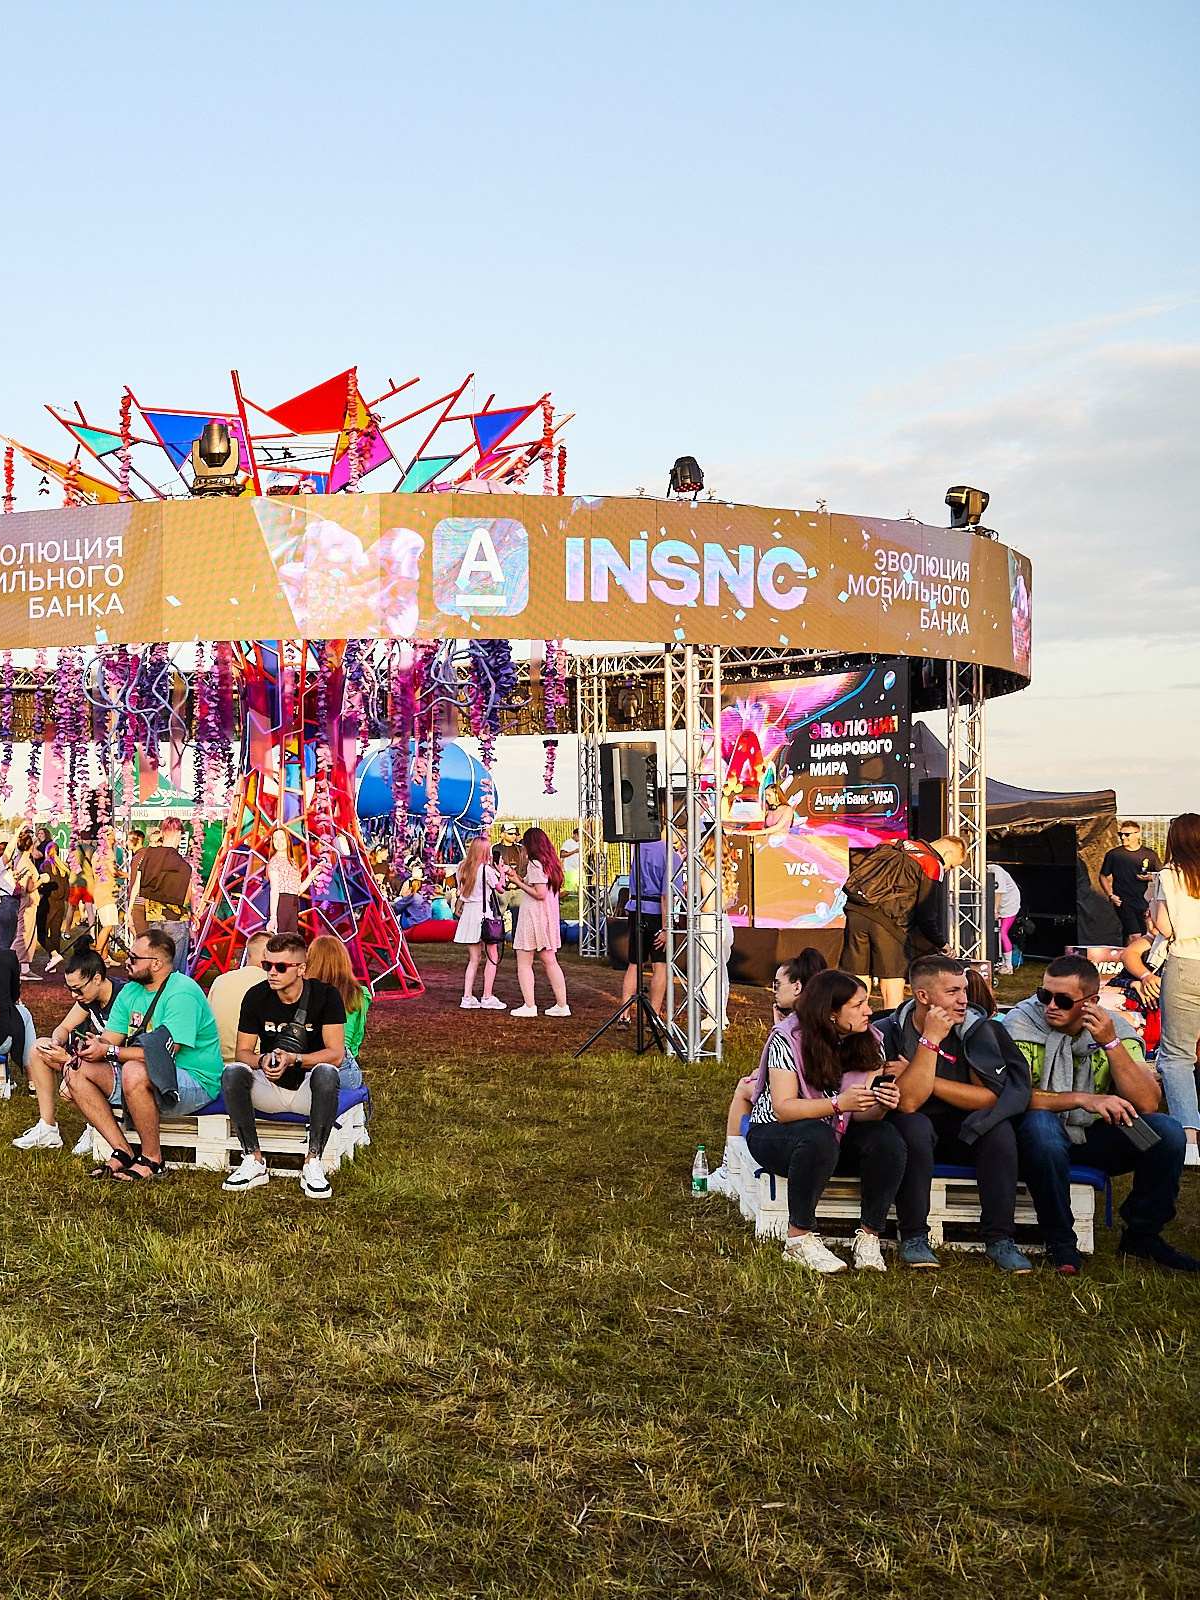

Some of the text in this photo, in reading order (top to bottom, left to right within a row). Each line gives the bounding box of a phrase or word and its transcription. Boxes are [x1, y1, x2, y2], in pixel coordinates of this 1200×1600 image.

[565, 536, 808, 611] INSNC
[874, 548, 970, 583] ЭВОЛЮЦИЯ
[847, 573, 970, 609] МОБИЛЬНОГО
[29, 592, 124, 619] БАНКА
[920, 607, 970, 635] БАНКА
[808, 715, 899, 740] ЭВОЛЮЦИЯ
[810, 738, 893, 760] ЦИФРОВОГО
[809, 761, 849, 777] МИРА
[846, 790, 869, 806] Банк
[872, 790, 894, 805] VISA
[783, 862, 819, 876] VISA
[1094, 961, 1124, 975] VISA
